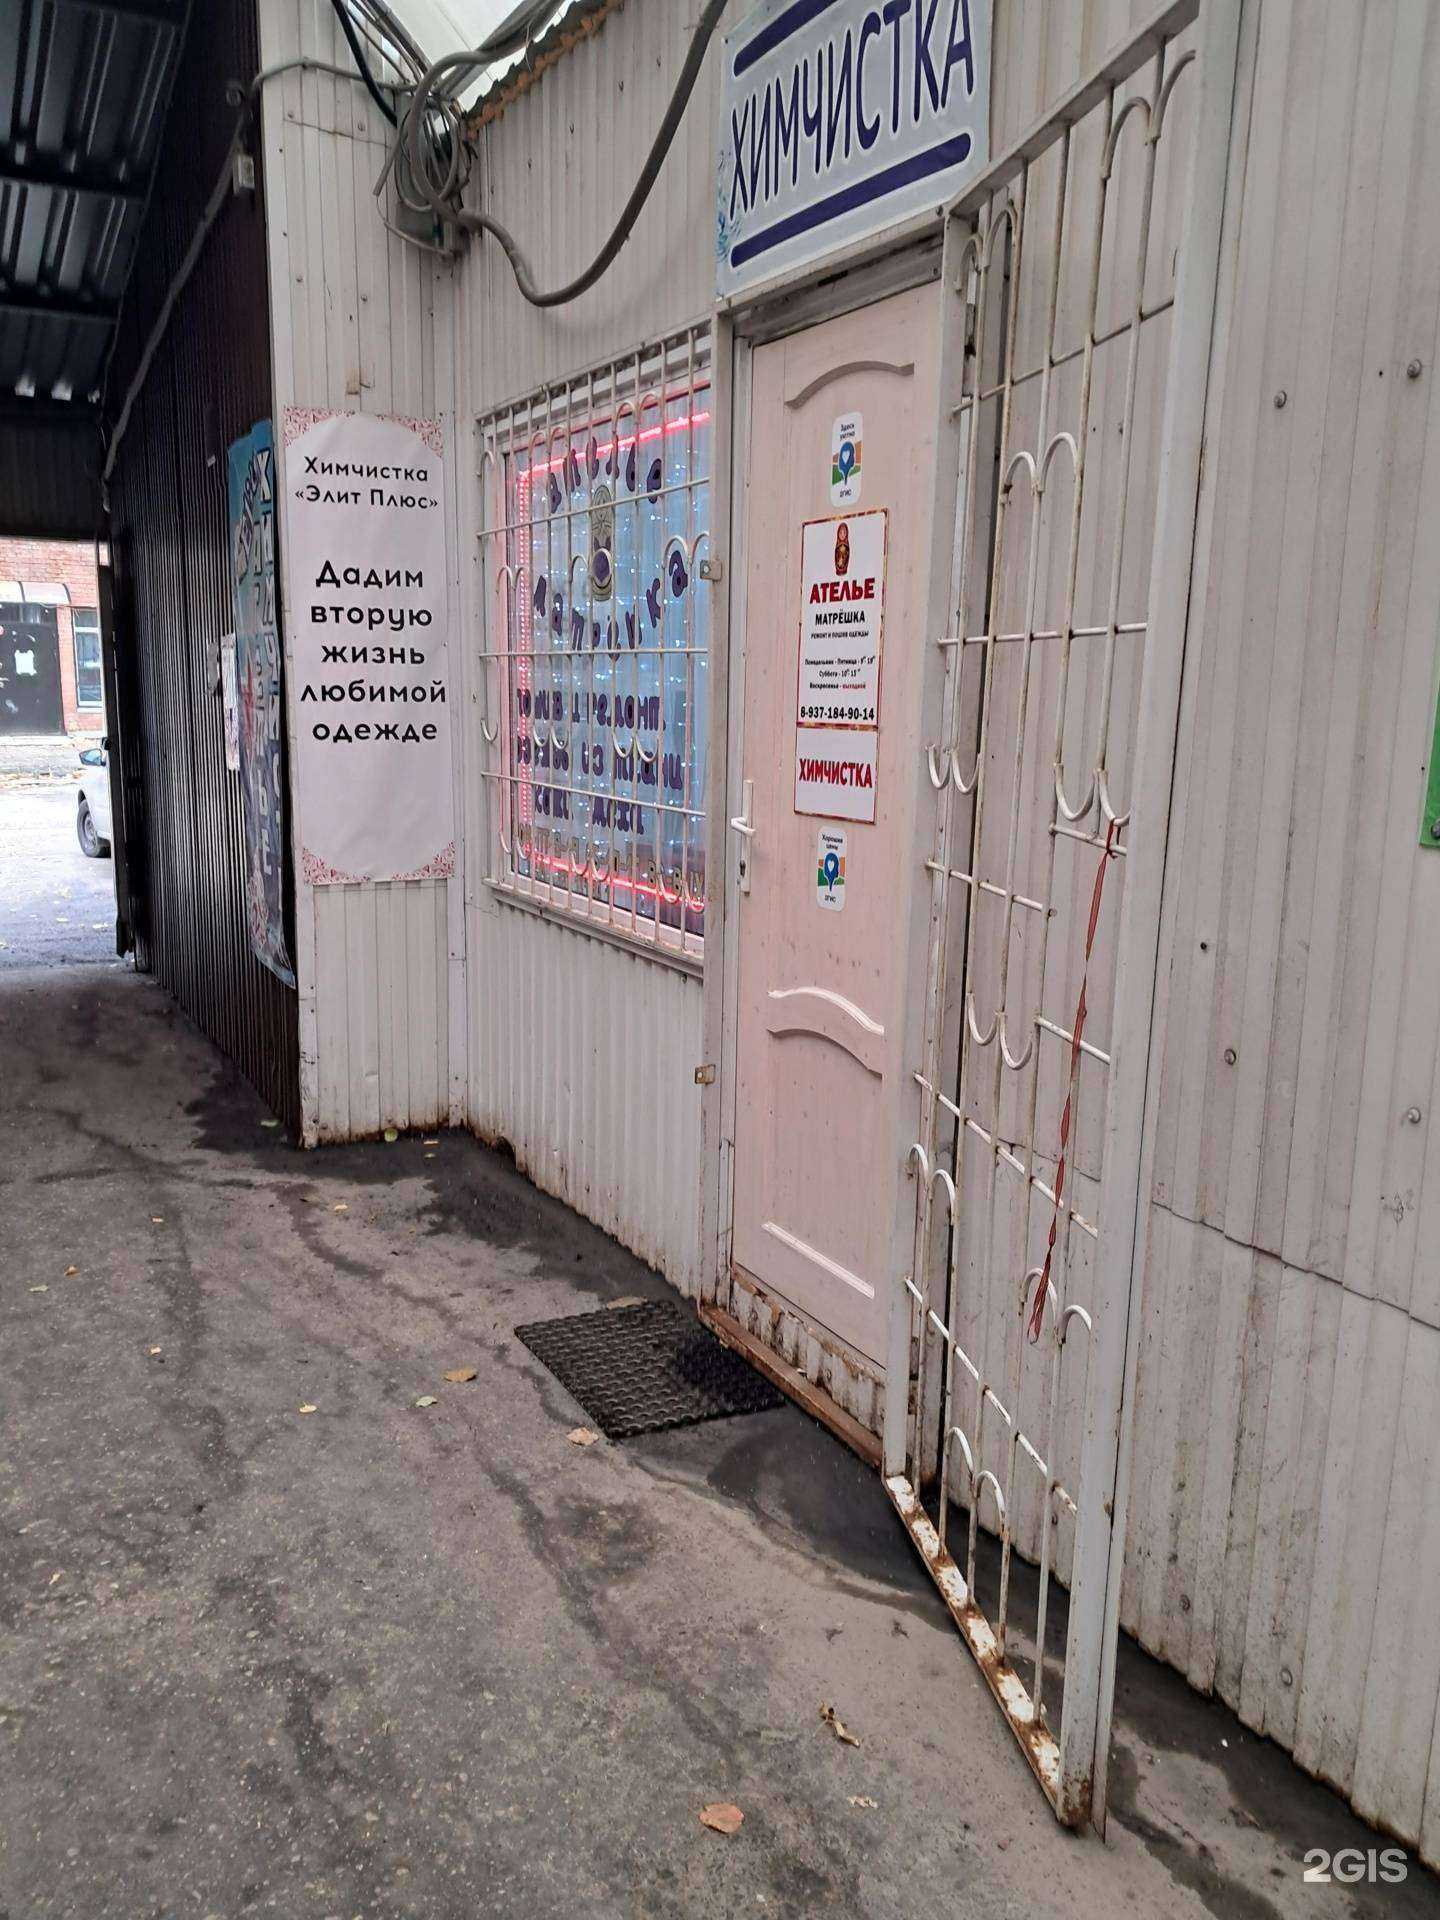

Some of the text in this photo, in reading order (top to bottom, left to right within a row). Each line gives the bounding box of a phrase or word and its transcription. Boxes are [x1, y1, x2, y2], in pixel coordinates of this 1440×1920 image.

[730, 0, 974, 221] ХИМЧИСТКА
[304, 456, 428, 482] Химчистка
[295, 485, 438, 509] «Элит Плюс»
[315, 560, 424, 589] Дадим
[809, 578, 876, 604] АТЕЛЬЕ
[311, 605, 432, 631] вторую
[815, 609, 866, 626] МАТРЁШКА
[321, 646, 425, 664] жизнь
[300, 678, 446, 703] любимой
[800, 706, 875, 720] 8-937-184-90-14
[312, 723, 438, 743] одежде
[799, 758, 873, 788] ХИМЧИСТКА
